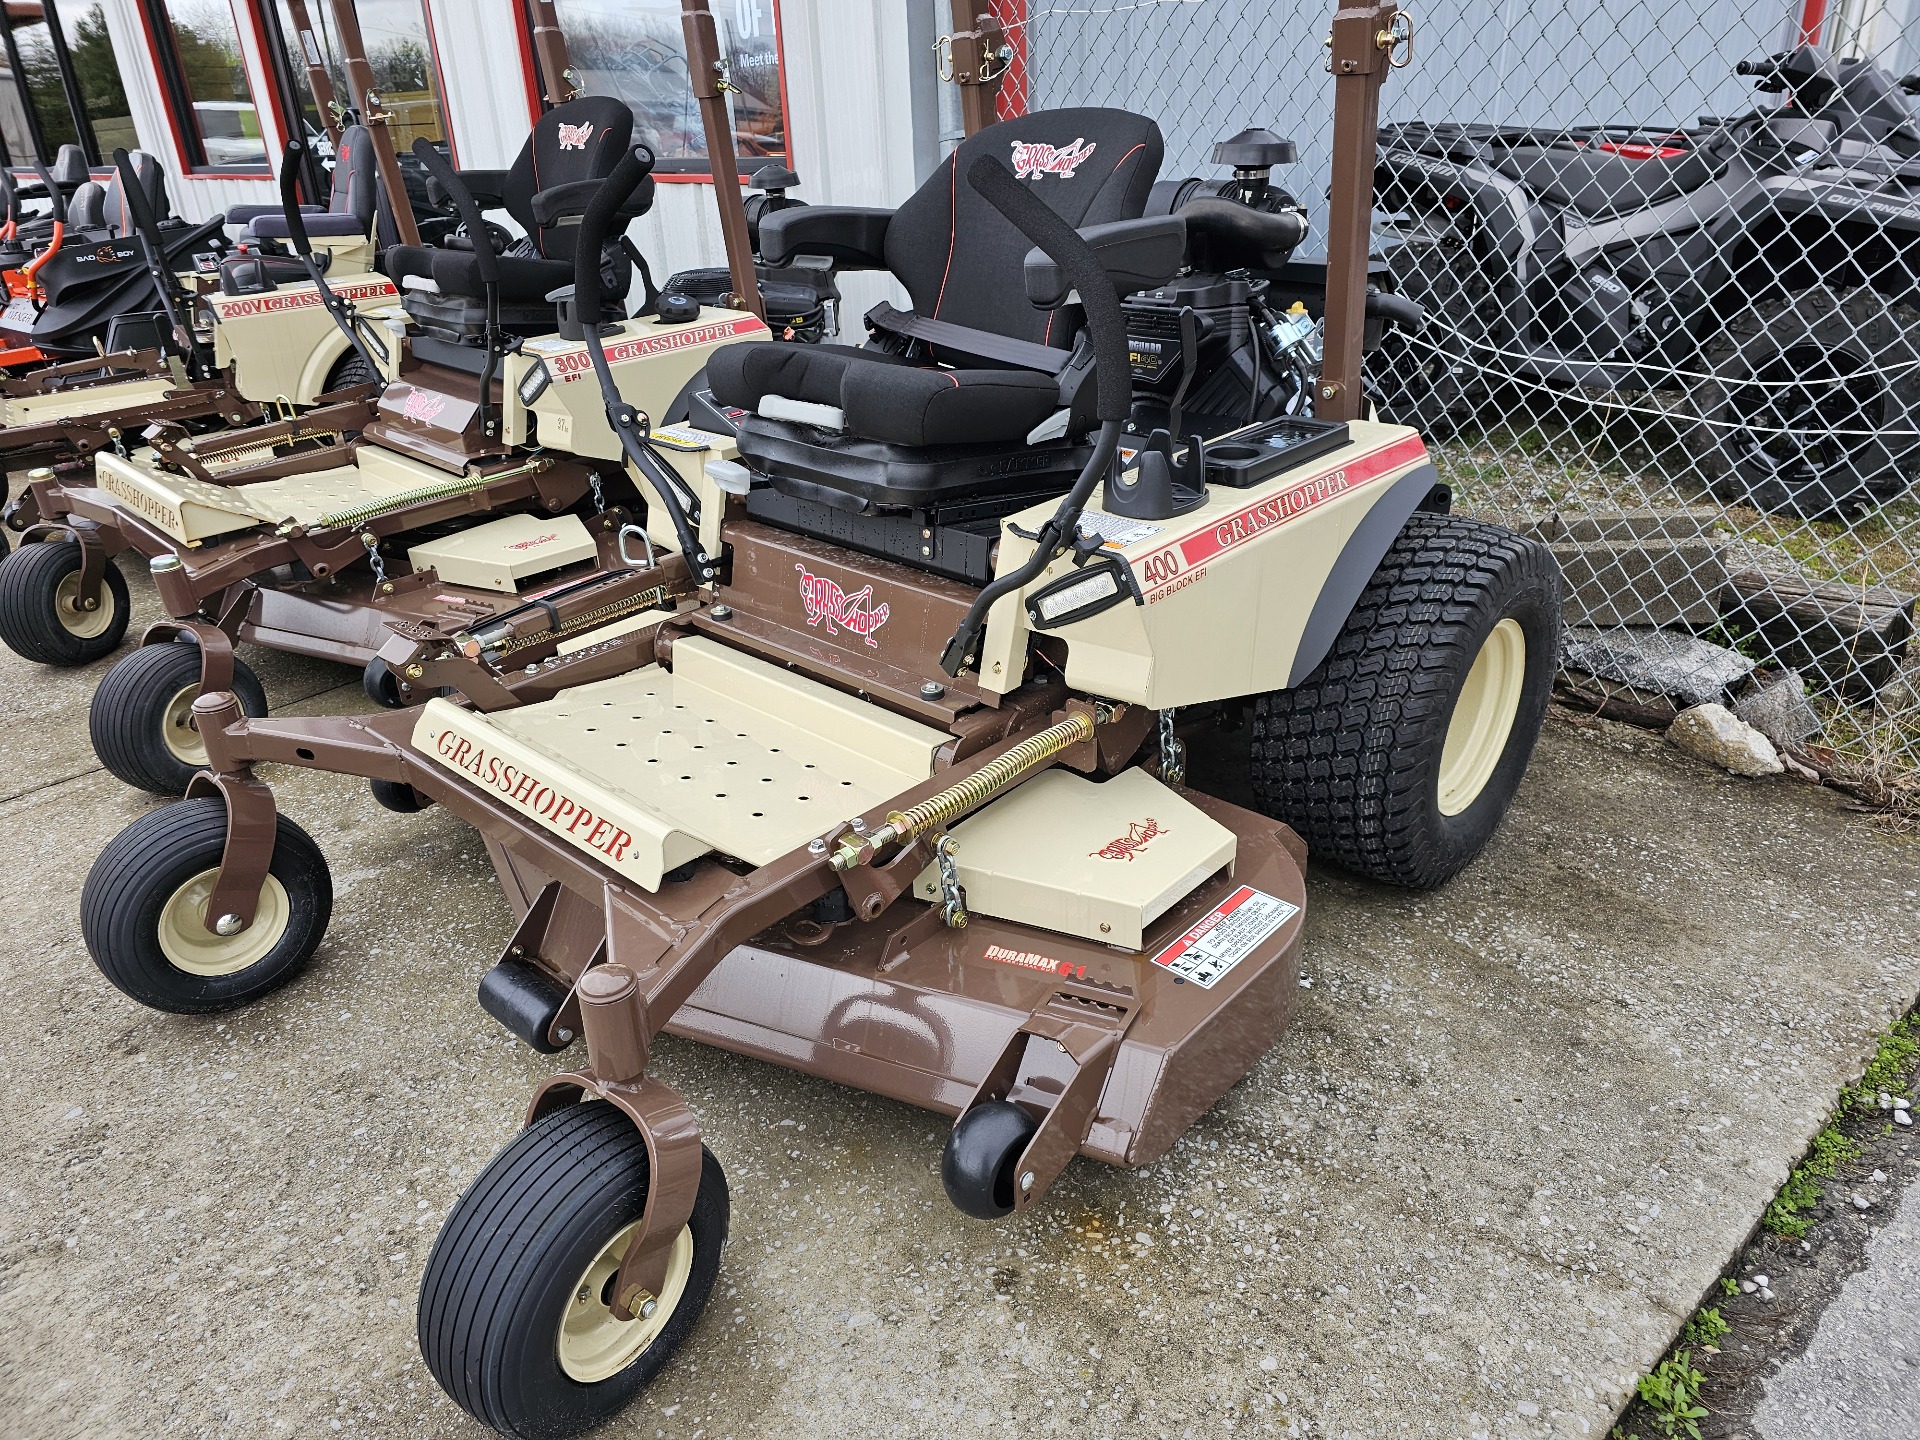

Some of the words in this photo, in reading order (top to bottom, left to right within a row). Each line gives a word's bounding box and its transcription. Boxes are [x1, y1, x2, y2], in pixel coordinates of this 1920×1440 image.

[740, 53, 764, 68] Meet
[76, 255, 96, 263] BAD
[116, 250, 135, 258] BOY
[221, 299, 262, 318] 200V
[268, 284, 387, 311] GRASSOPPER
[555, 352, 591, 373] 300
[614, 323, 736, 360] GRASSHOPPER
[564, 373, 582, 382] EFI
[102, 470, 176, 531] GRASSHOPPER
[1144, 550, 1179, 585] 400
[1216, 471, 1350, 549] GRASSHOPPER
[1150, 590, 1164, 605] BIG
[1166, 577, 1194, 596] BLOCK
[1195, 568, 1207, 582] EFI
[436, 729, 632, 863] GRASSHOPPER
[1187, 910, 1226, 939] DANGER
[1059, 961, 1086, 977] 61
